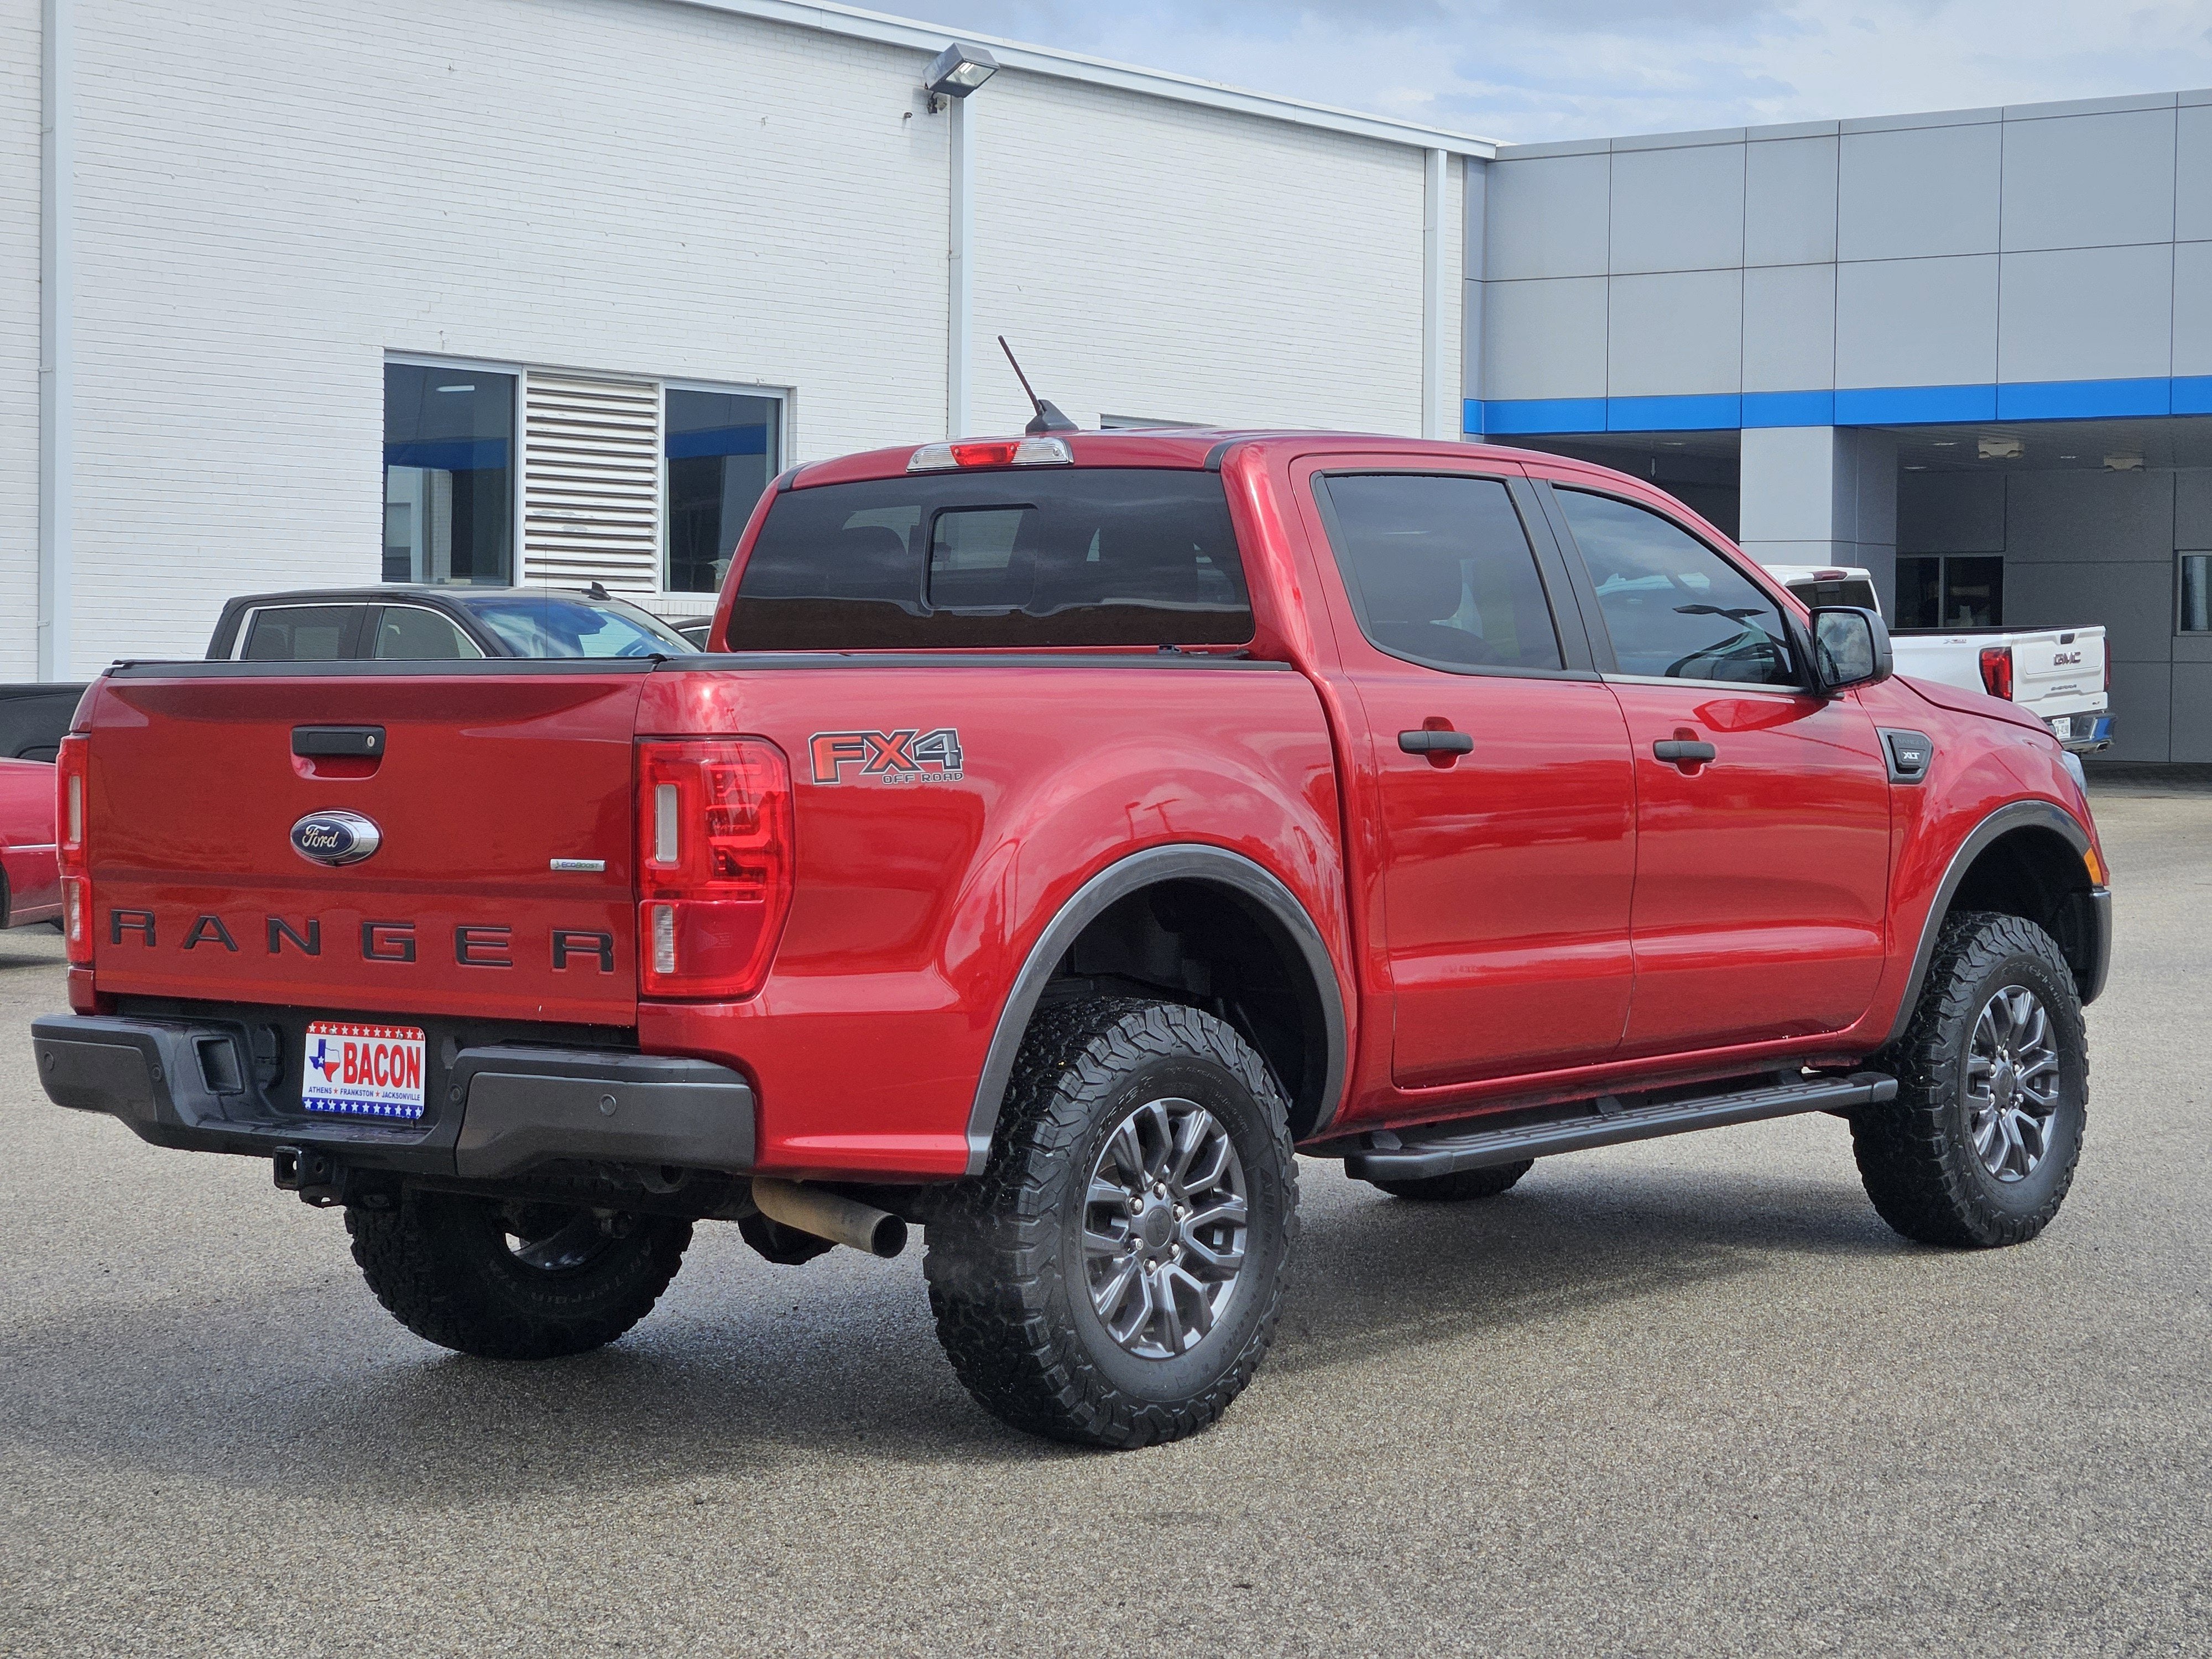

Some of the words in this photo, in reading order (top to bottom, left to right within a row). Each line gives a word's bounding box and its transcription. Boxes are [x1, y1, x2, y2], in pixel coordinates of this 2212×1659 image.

[2053, 651, 2081, 666] GMC
[808, 728, 963, 785] FX4
[1902, 752, 1920, 760] XLT
[883, 775, 915, 784] OFF
[921, 773, 963, 782] ROAD
[302, 824, 340, 848] Ford
[111, 909, 614, 972] RANGER
[343, 1042, 421, 1089] BACON
[340, 1088, 374, 1097] FRANKSTON
[382, 1091, 420, 1100] JACKSONVILLE
